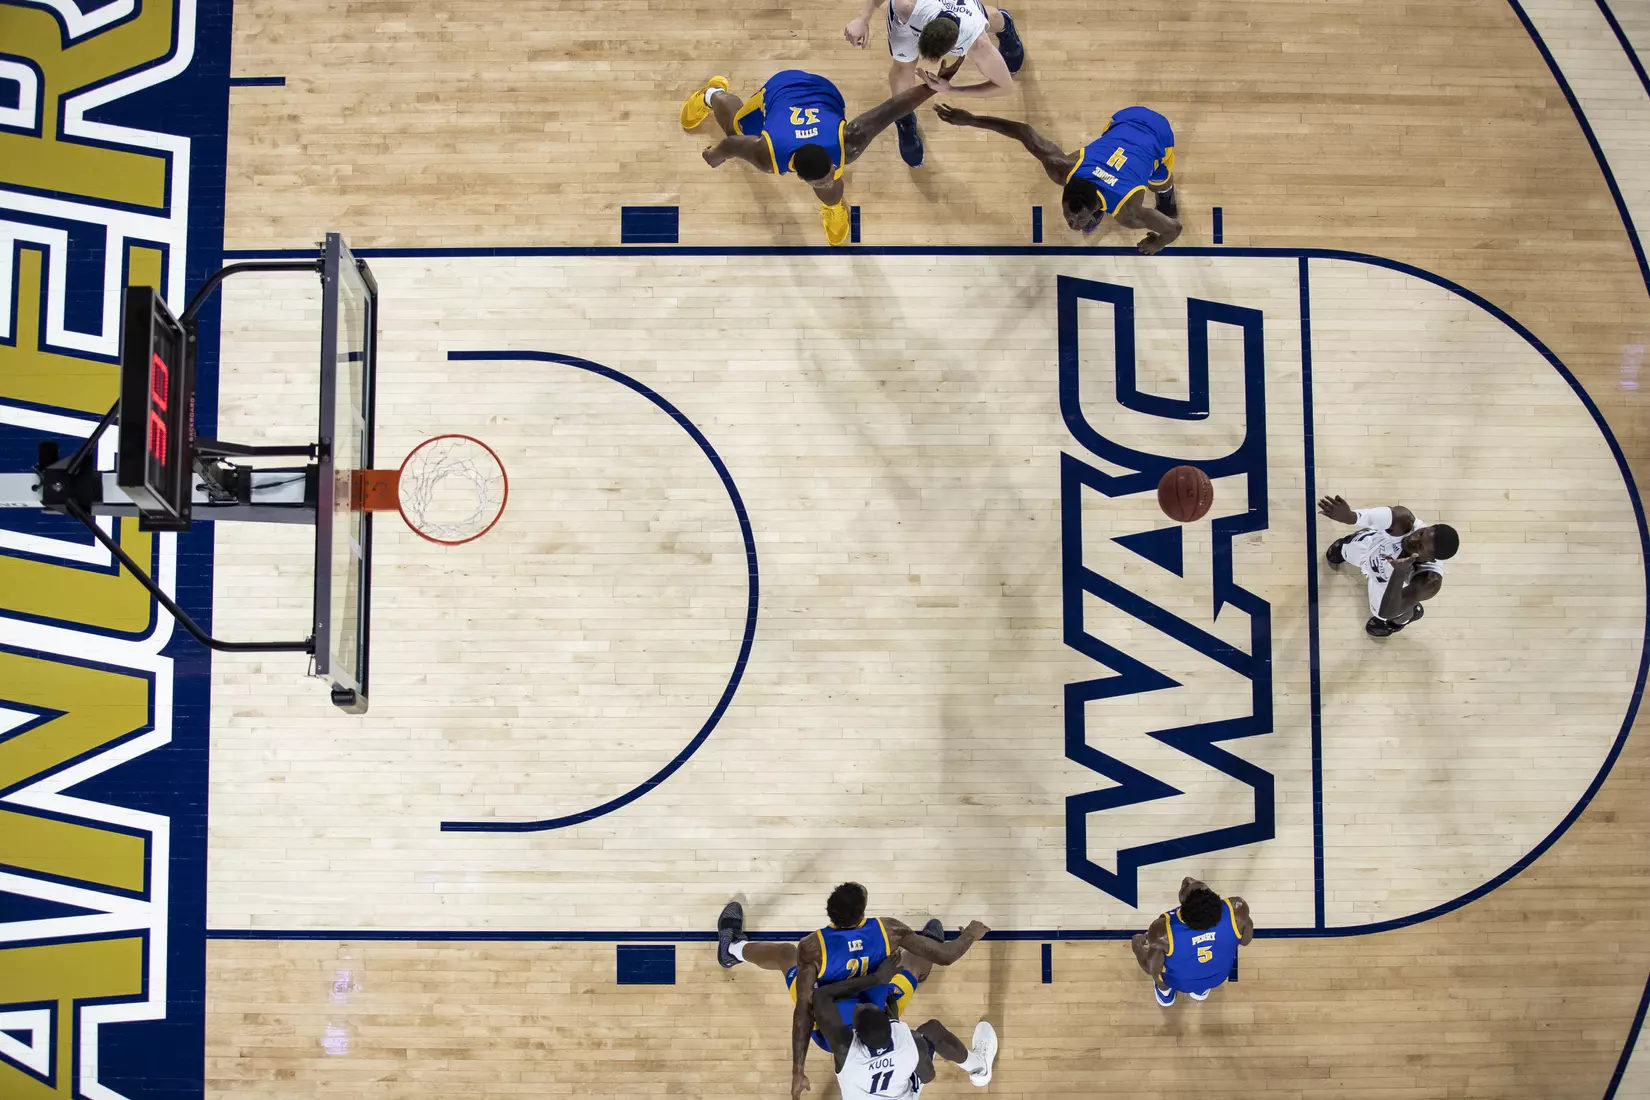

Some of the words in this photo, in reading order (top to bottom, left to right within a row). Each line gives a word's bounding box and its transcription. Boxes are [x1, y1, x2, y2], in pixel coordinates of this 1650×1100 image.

[938, 0, 972, 16] MORISO
[789, 106, 821, 126] 32
[795, 127, 819, 139] STITH
[1106, 147, 1128, 171] 4
[148, 351, 169, 467] 30
[188, 397, 196, 442] BACKBOARD
[1057, 274, 1276, 909] WAC
[847, 939, 864, 952] LEE
[1197, 945, 1213, 964] 5
[846, 956, 869, 980] 21
[868, 1057, 895, 1071] KUOL
[869, 1069, 895, 1094] 11
